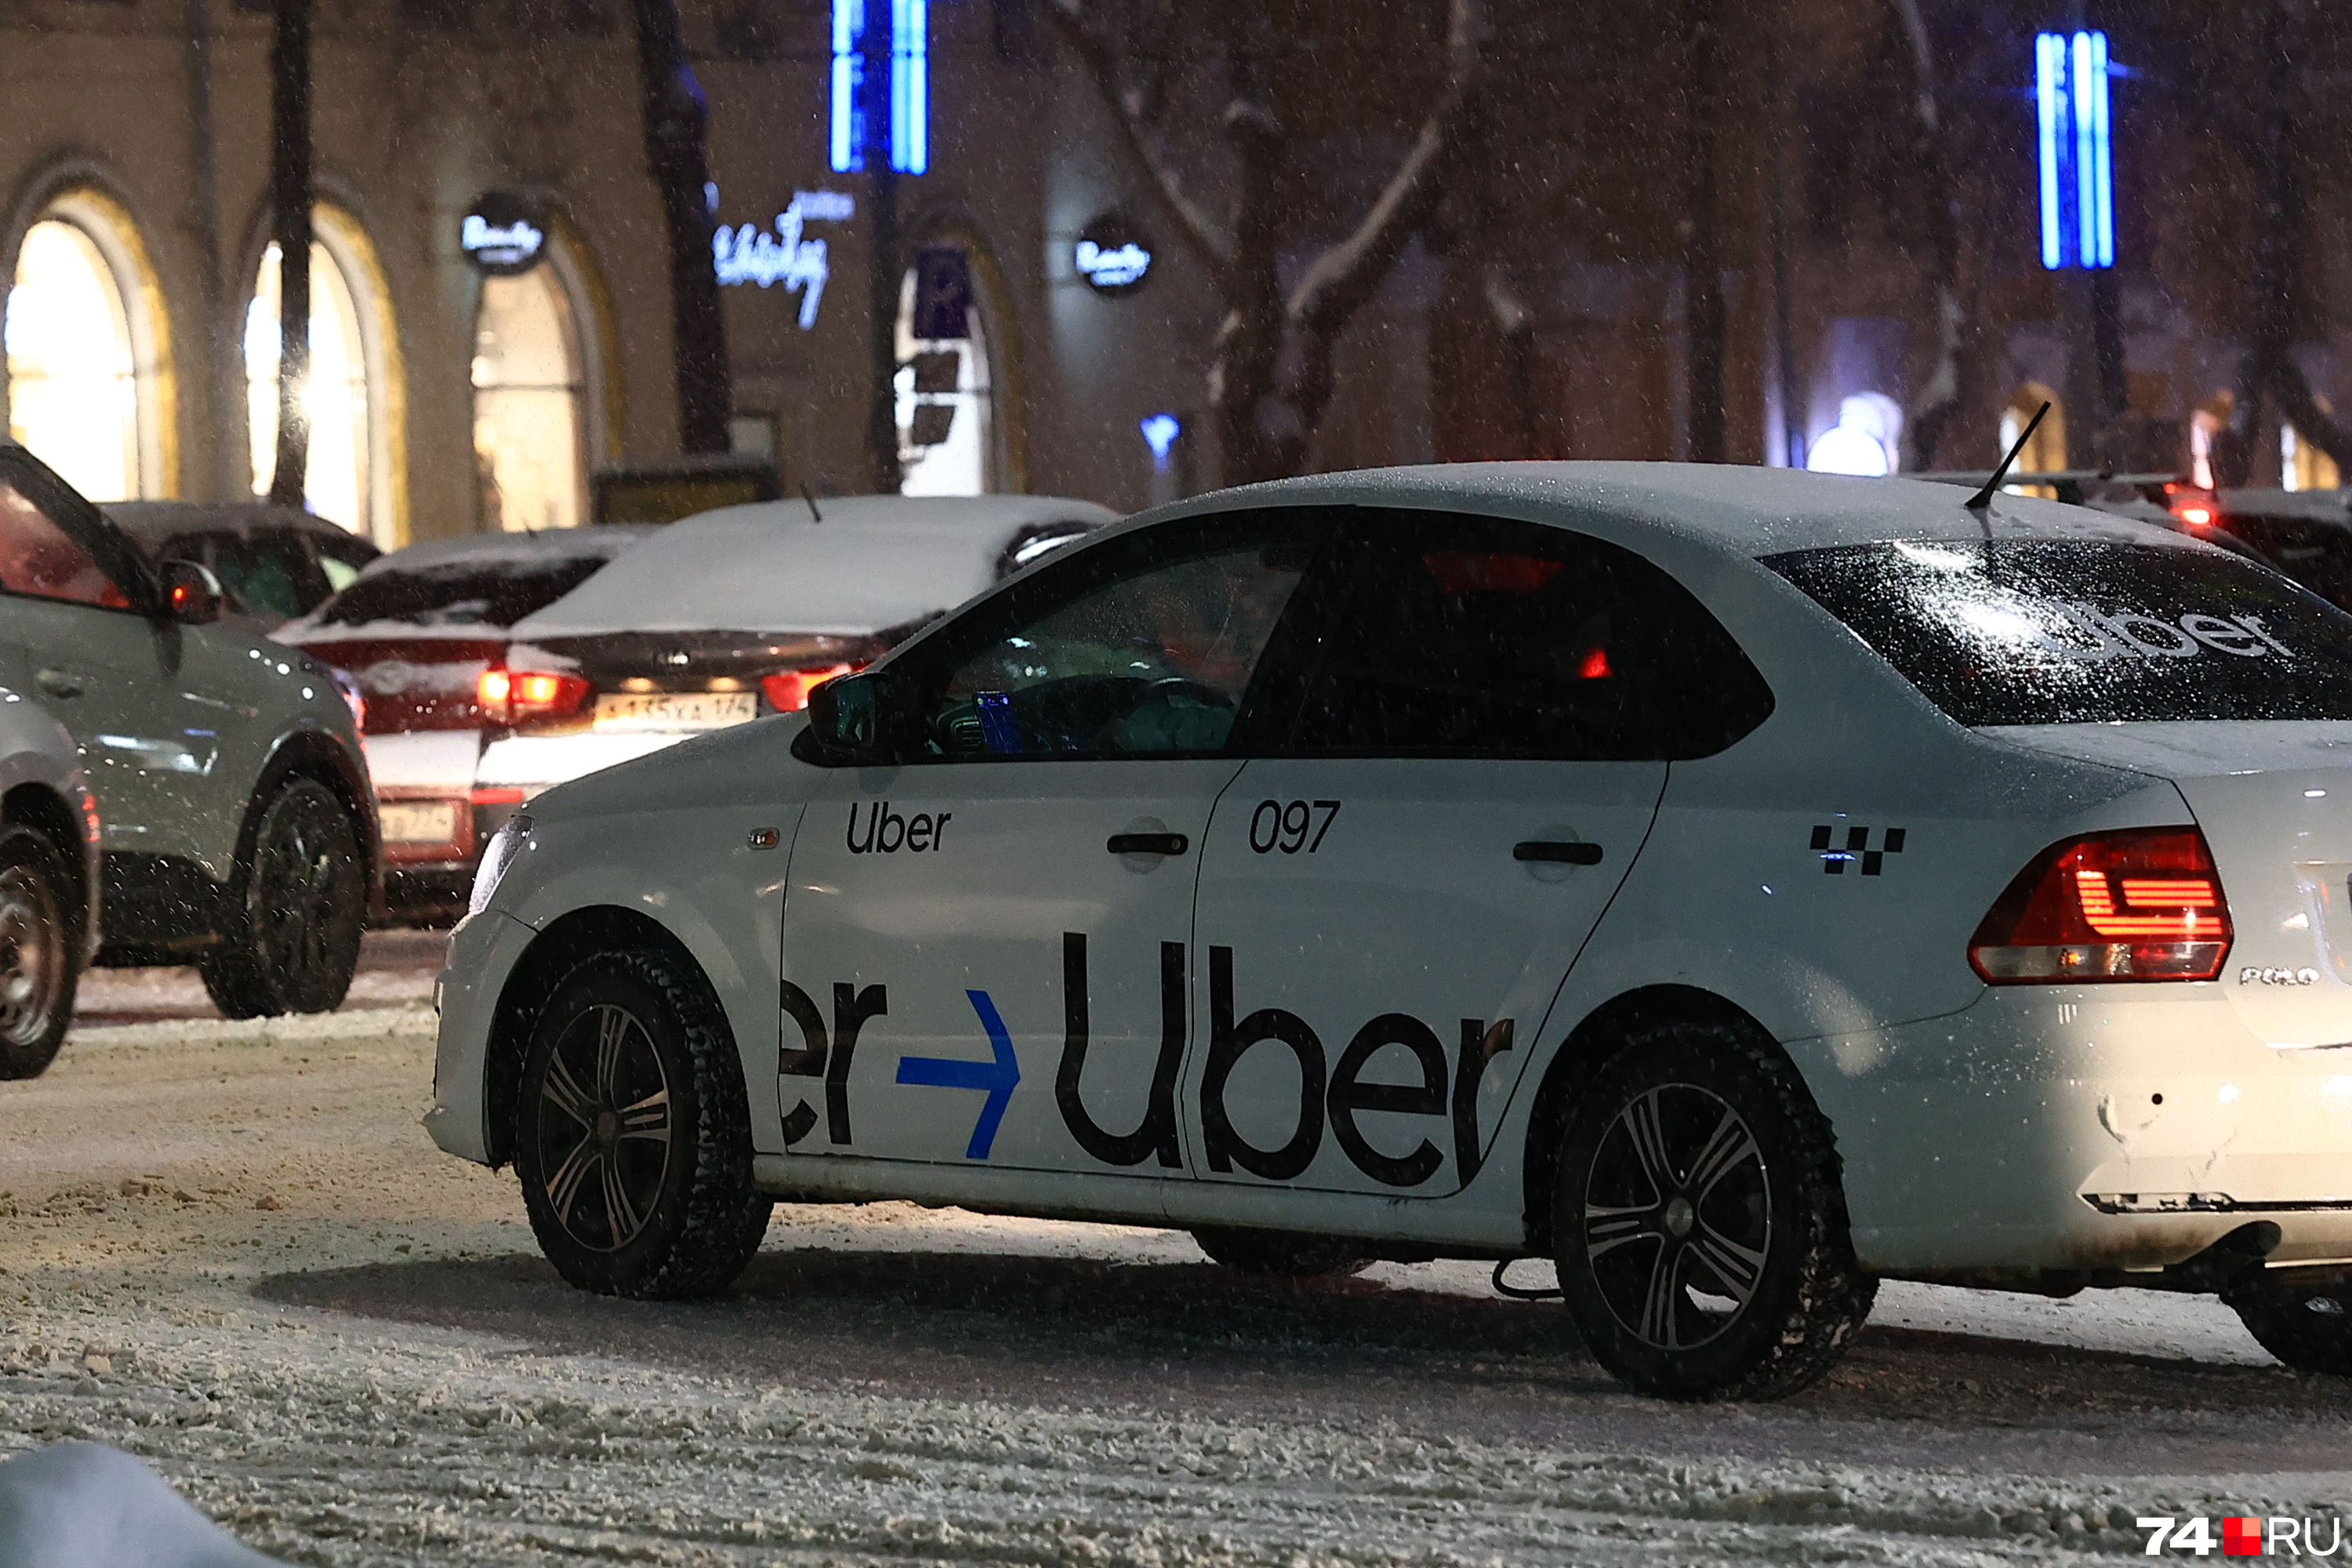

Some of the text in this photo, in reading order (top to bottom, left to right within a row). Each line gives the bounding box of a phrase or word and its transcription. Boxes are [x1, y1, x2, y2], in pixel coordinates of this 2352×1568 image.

[2019, 600, 2296, 659] Uber
[847, 801, 951, 854] Uber
[1249, 800, 1341, 854] 097
[1055, 931, 1514, 1189] Uber
